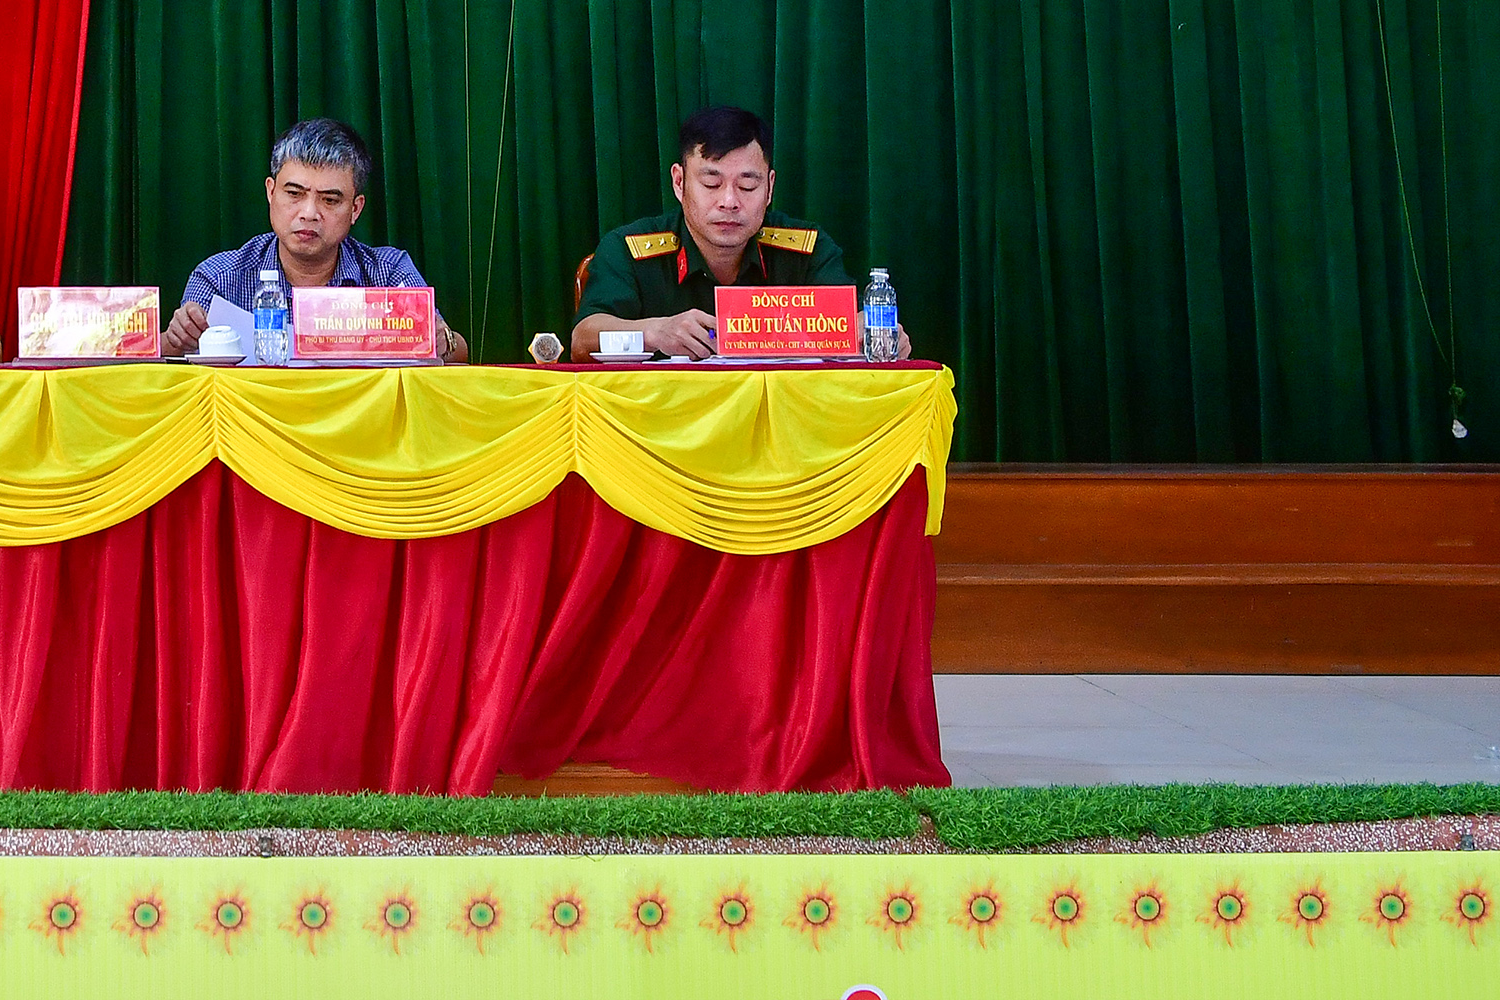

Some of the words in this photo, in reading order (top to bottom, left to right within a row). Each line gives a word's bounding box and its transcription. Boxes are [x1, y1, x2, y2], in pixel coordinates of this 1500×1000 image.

[752, 291, 788, 307] ĐỒNG
[791, 291, 815, 307] CHÍ
[726, 314, 761, 333] KIỀU
[764, 313, 803, 333] TUẤN
[806, 313, 848, 332] HỒNG
